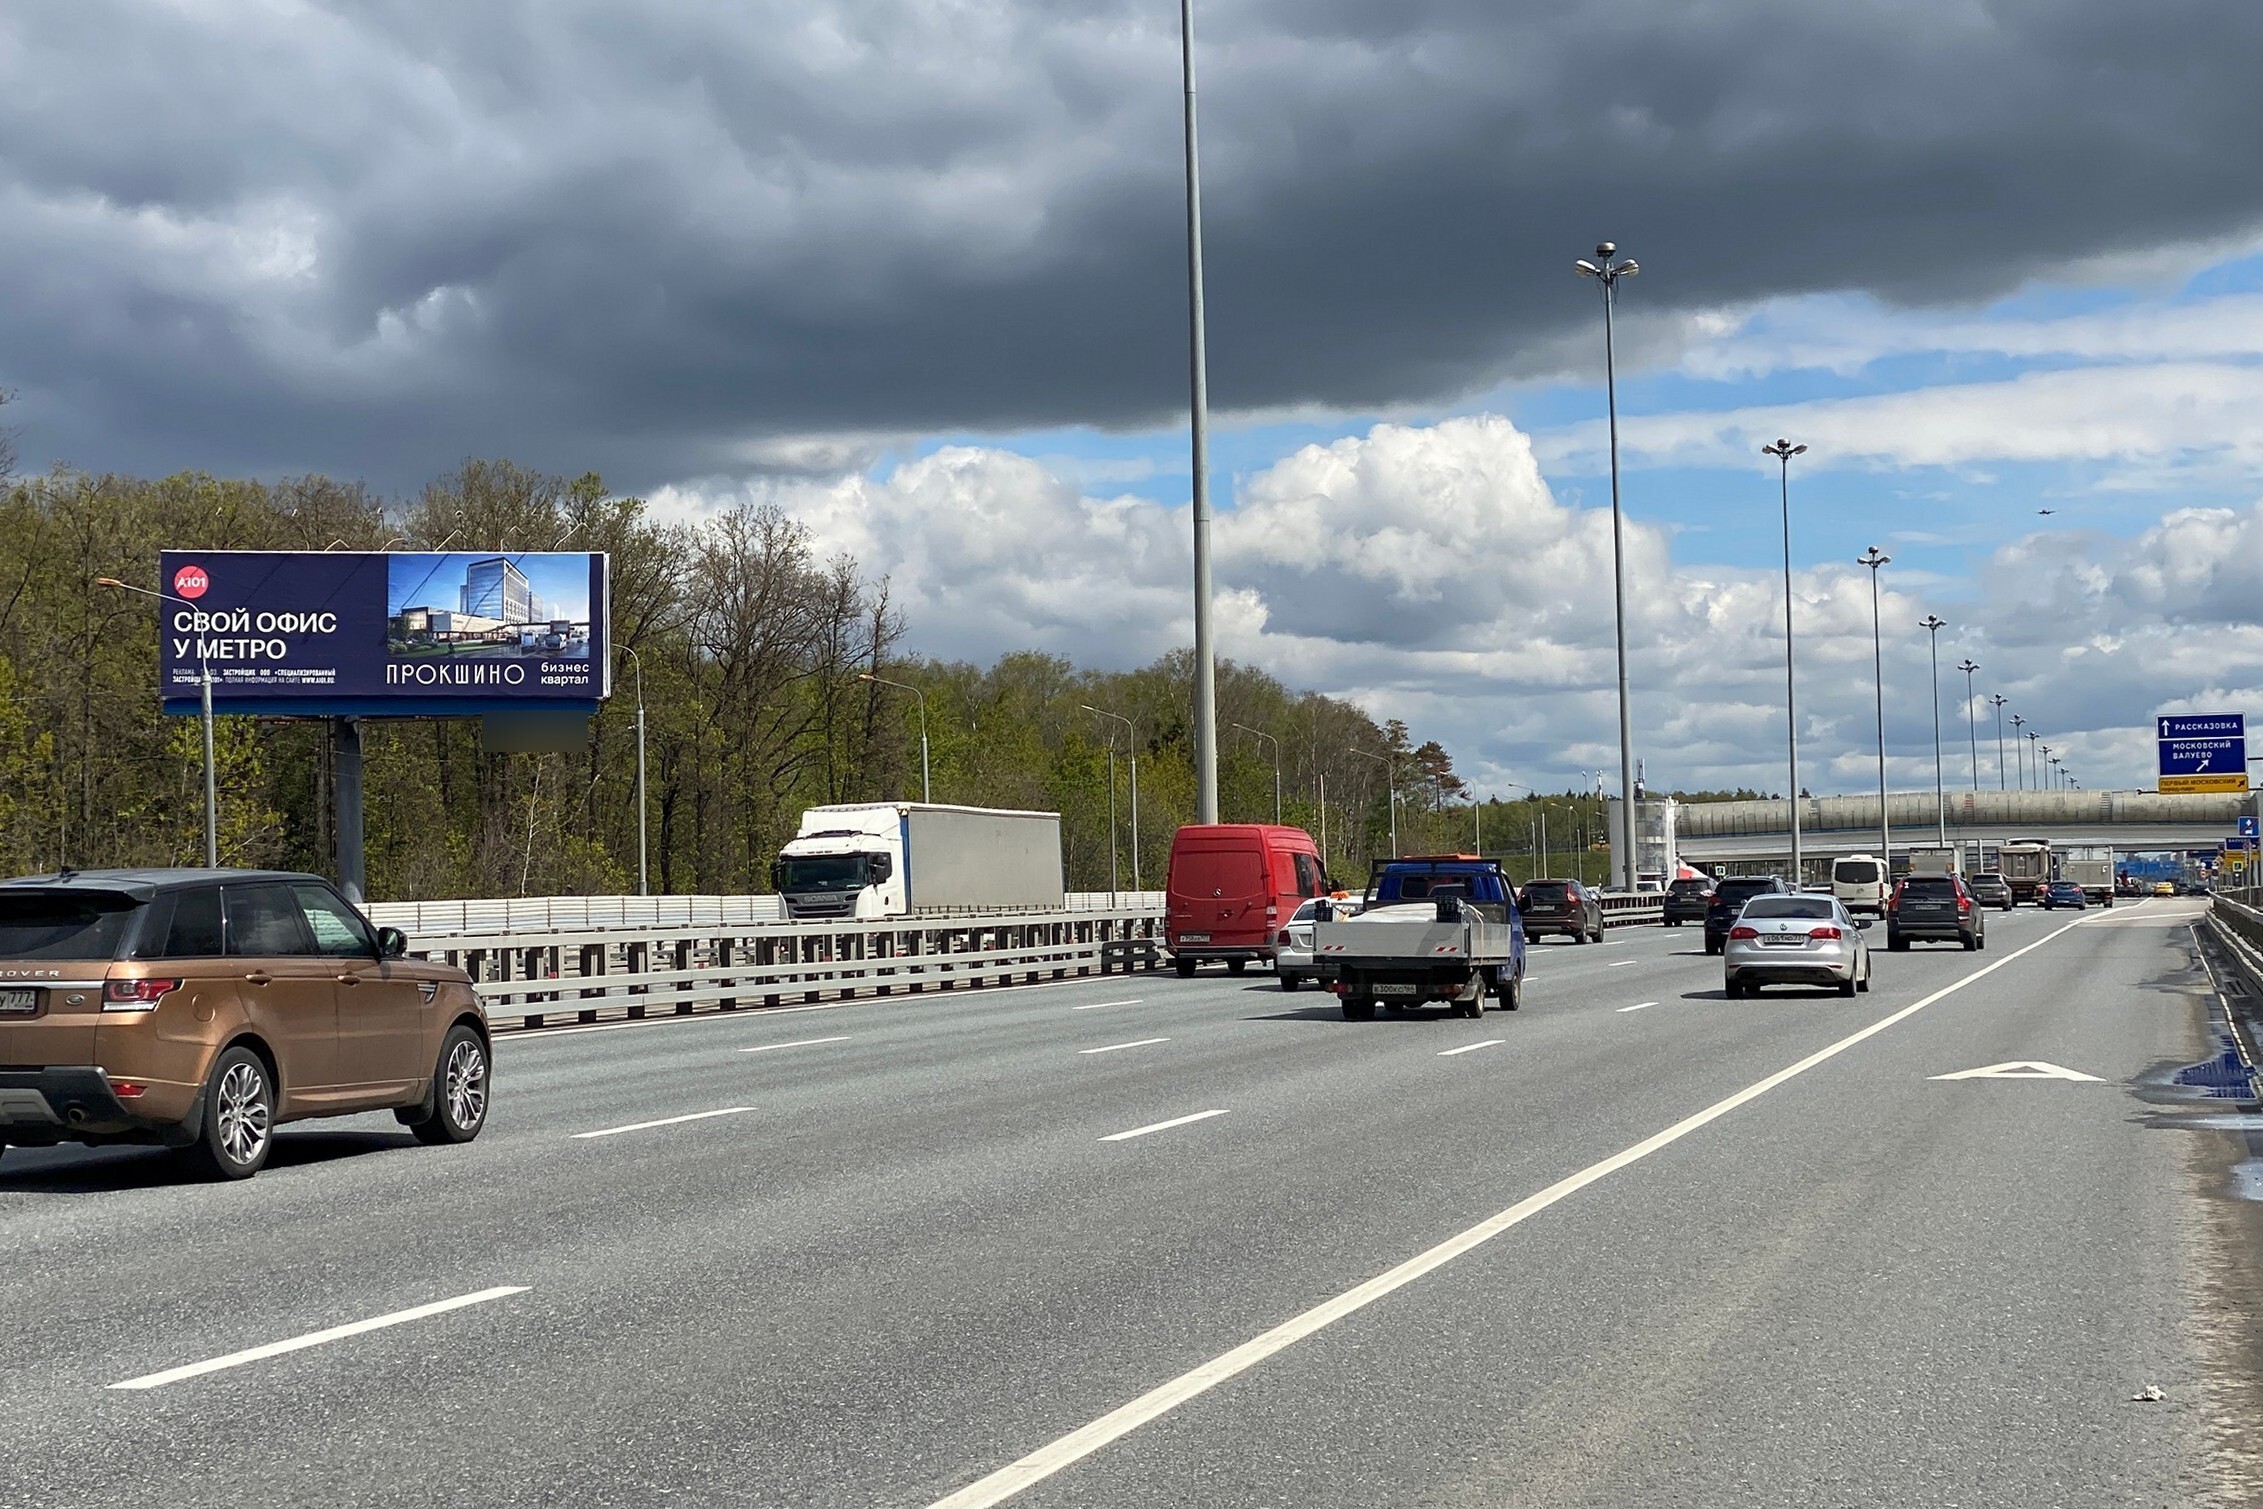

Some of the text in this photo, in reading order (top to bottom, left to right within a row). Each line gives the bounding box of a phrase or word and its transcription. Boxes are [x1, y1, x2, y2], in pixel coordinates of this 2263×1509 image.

[173, 607, 337, 633] СВОЙ ОФИС
[172, 638, 287, 660] У МЕТРО
[259, 668, 271, 676] ООО
[540, 662, 590, 673] бизнес
[386, 664, 525, 685] ПРОКШИНО
[540, 675, 589, 687] квартал
[2174, 722, 2238, 731] РАССКАЗОВКА
[2172, 740, 2232, 750] МОСКОВСКИЙ
[2172, 751, 2213, 760] ВАЛУЕВО
